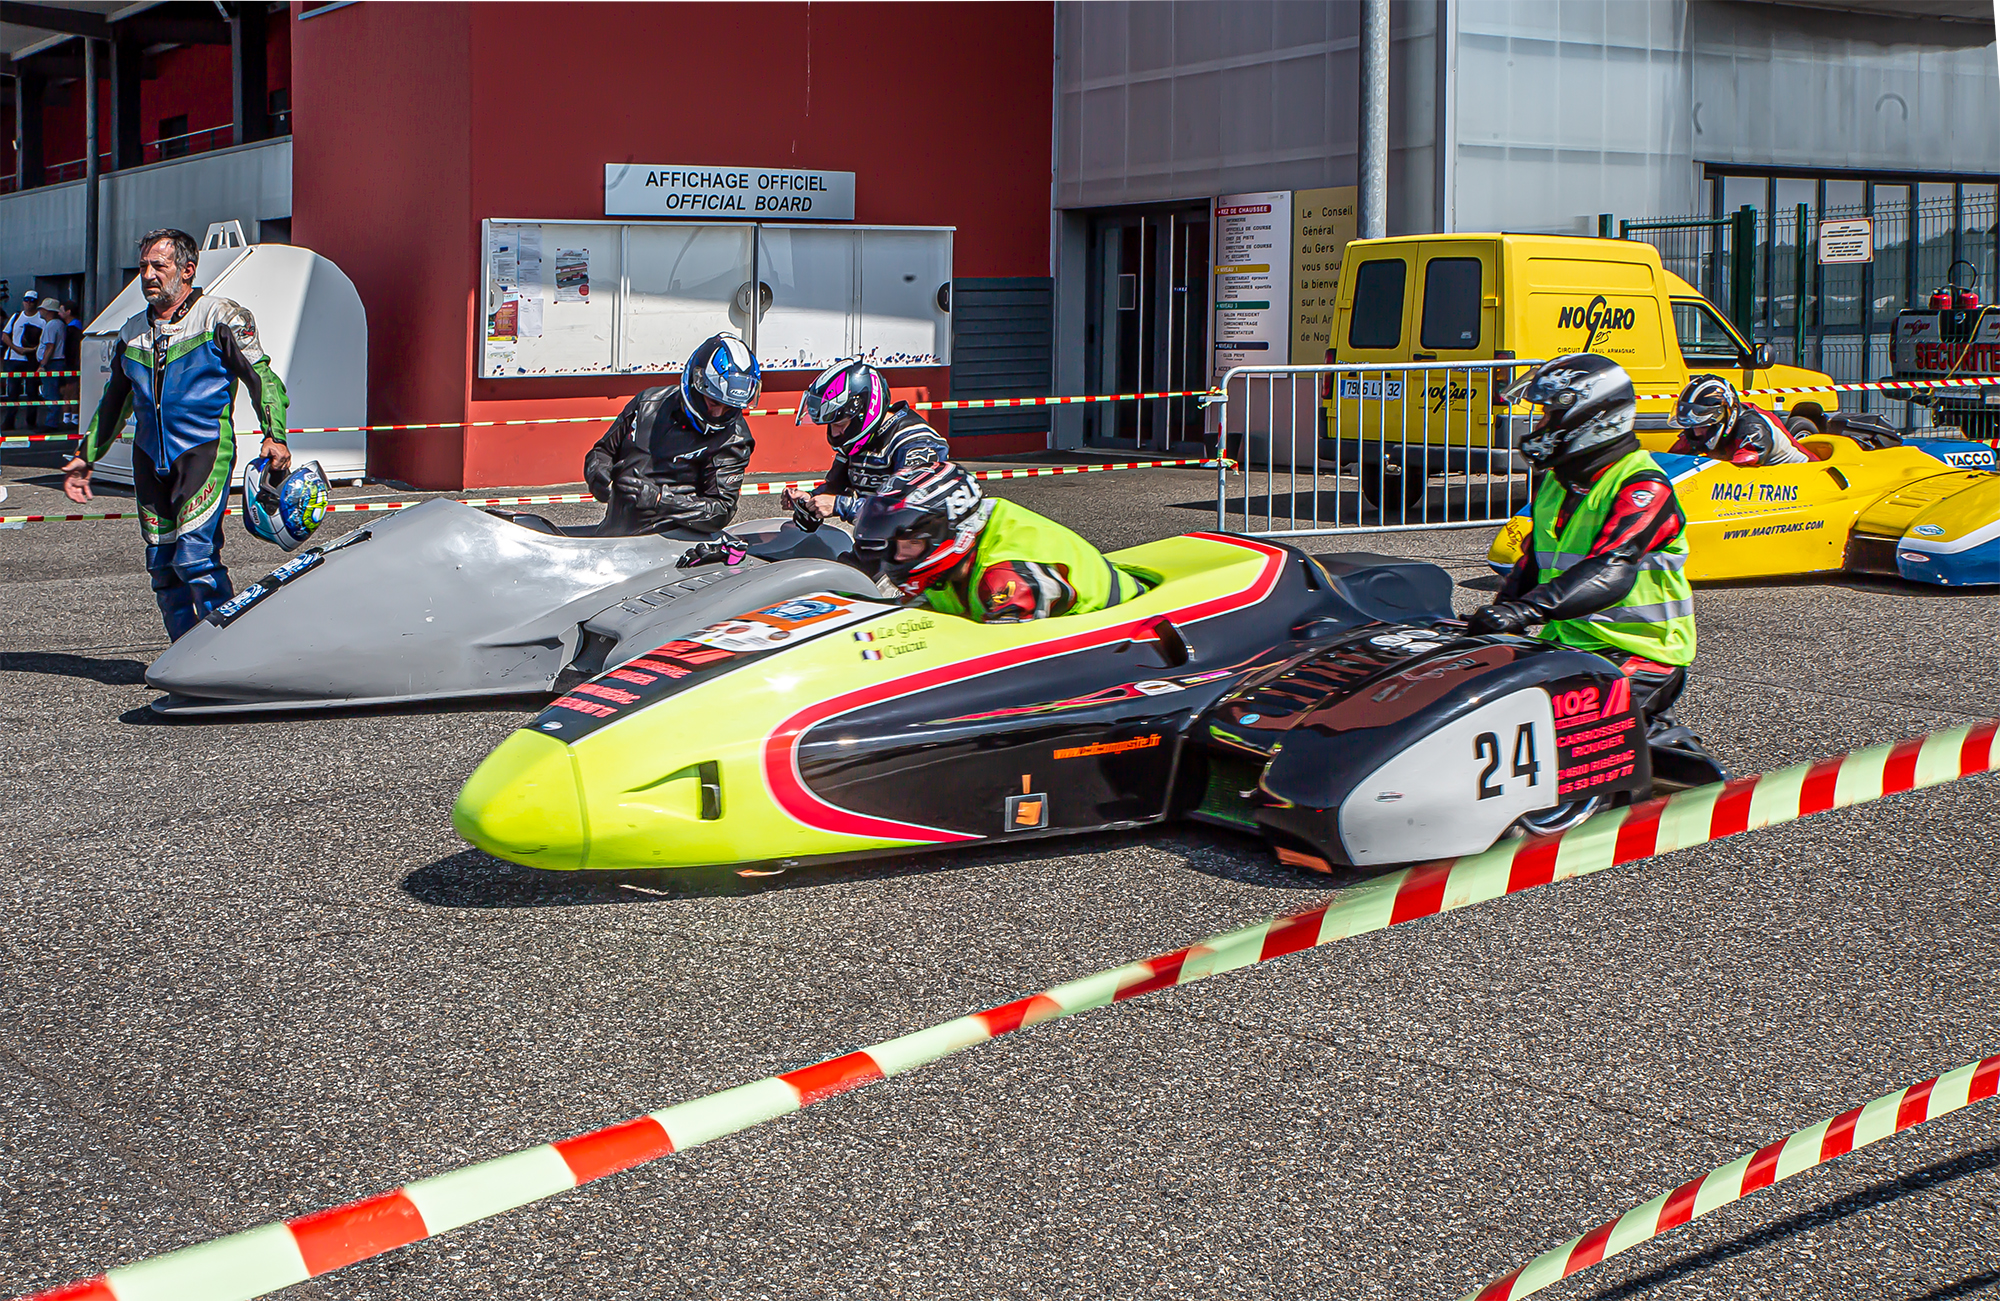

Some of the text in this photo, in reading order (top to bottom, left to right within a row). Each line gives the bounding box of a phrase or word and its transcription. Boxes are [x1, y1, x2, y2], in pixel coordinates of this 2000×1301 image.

[645, 171, 828, 191] AFFICHAGE OFFICIEL
[666, 193, 812, 212] OFFICIAL BOARD
[1302, 206, 1353, 218] Le Conseil
[1302, 225, 1334, 236] Général
[1302, 243, 1334, 254] du Gers
[1302, 263, 1321, 271] vous
[1301, 280, 1308, 289] la
[1302, 298, 1314, 306] sur
[1319, 297, 1326, 306] le
[1301, 315, 1318, 324] Paul
[1558, 295, 1635, 353] NOGARO
[1300, 332, 1329, 343] de Nog
[1387, 383, 1400, 396] 32
[1947, 453, 1991, 466] YACCO
[1711, 483, 1798, 502] MAQ-1 TRANS
[1552, 687, 1600, 718] 102
[1472, 721, 1541, 801] 24
[1574, 778, 1590, 790] 53
